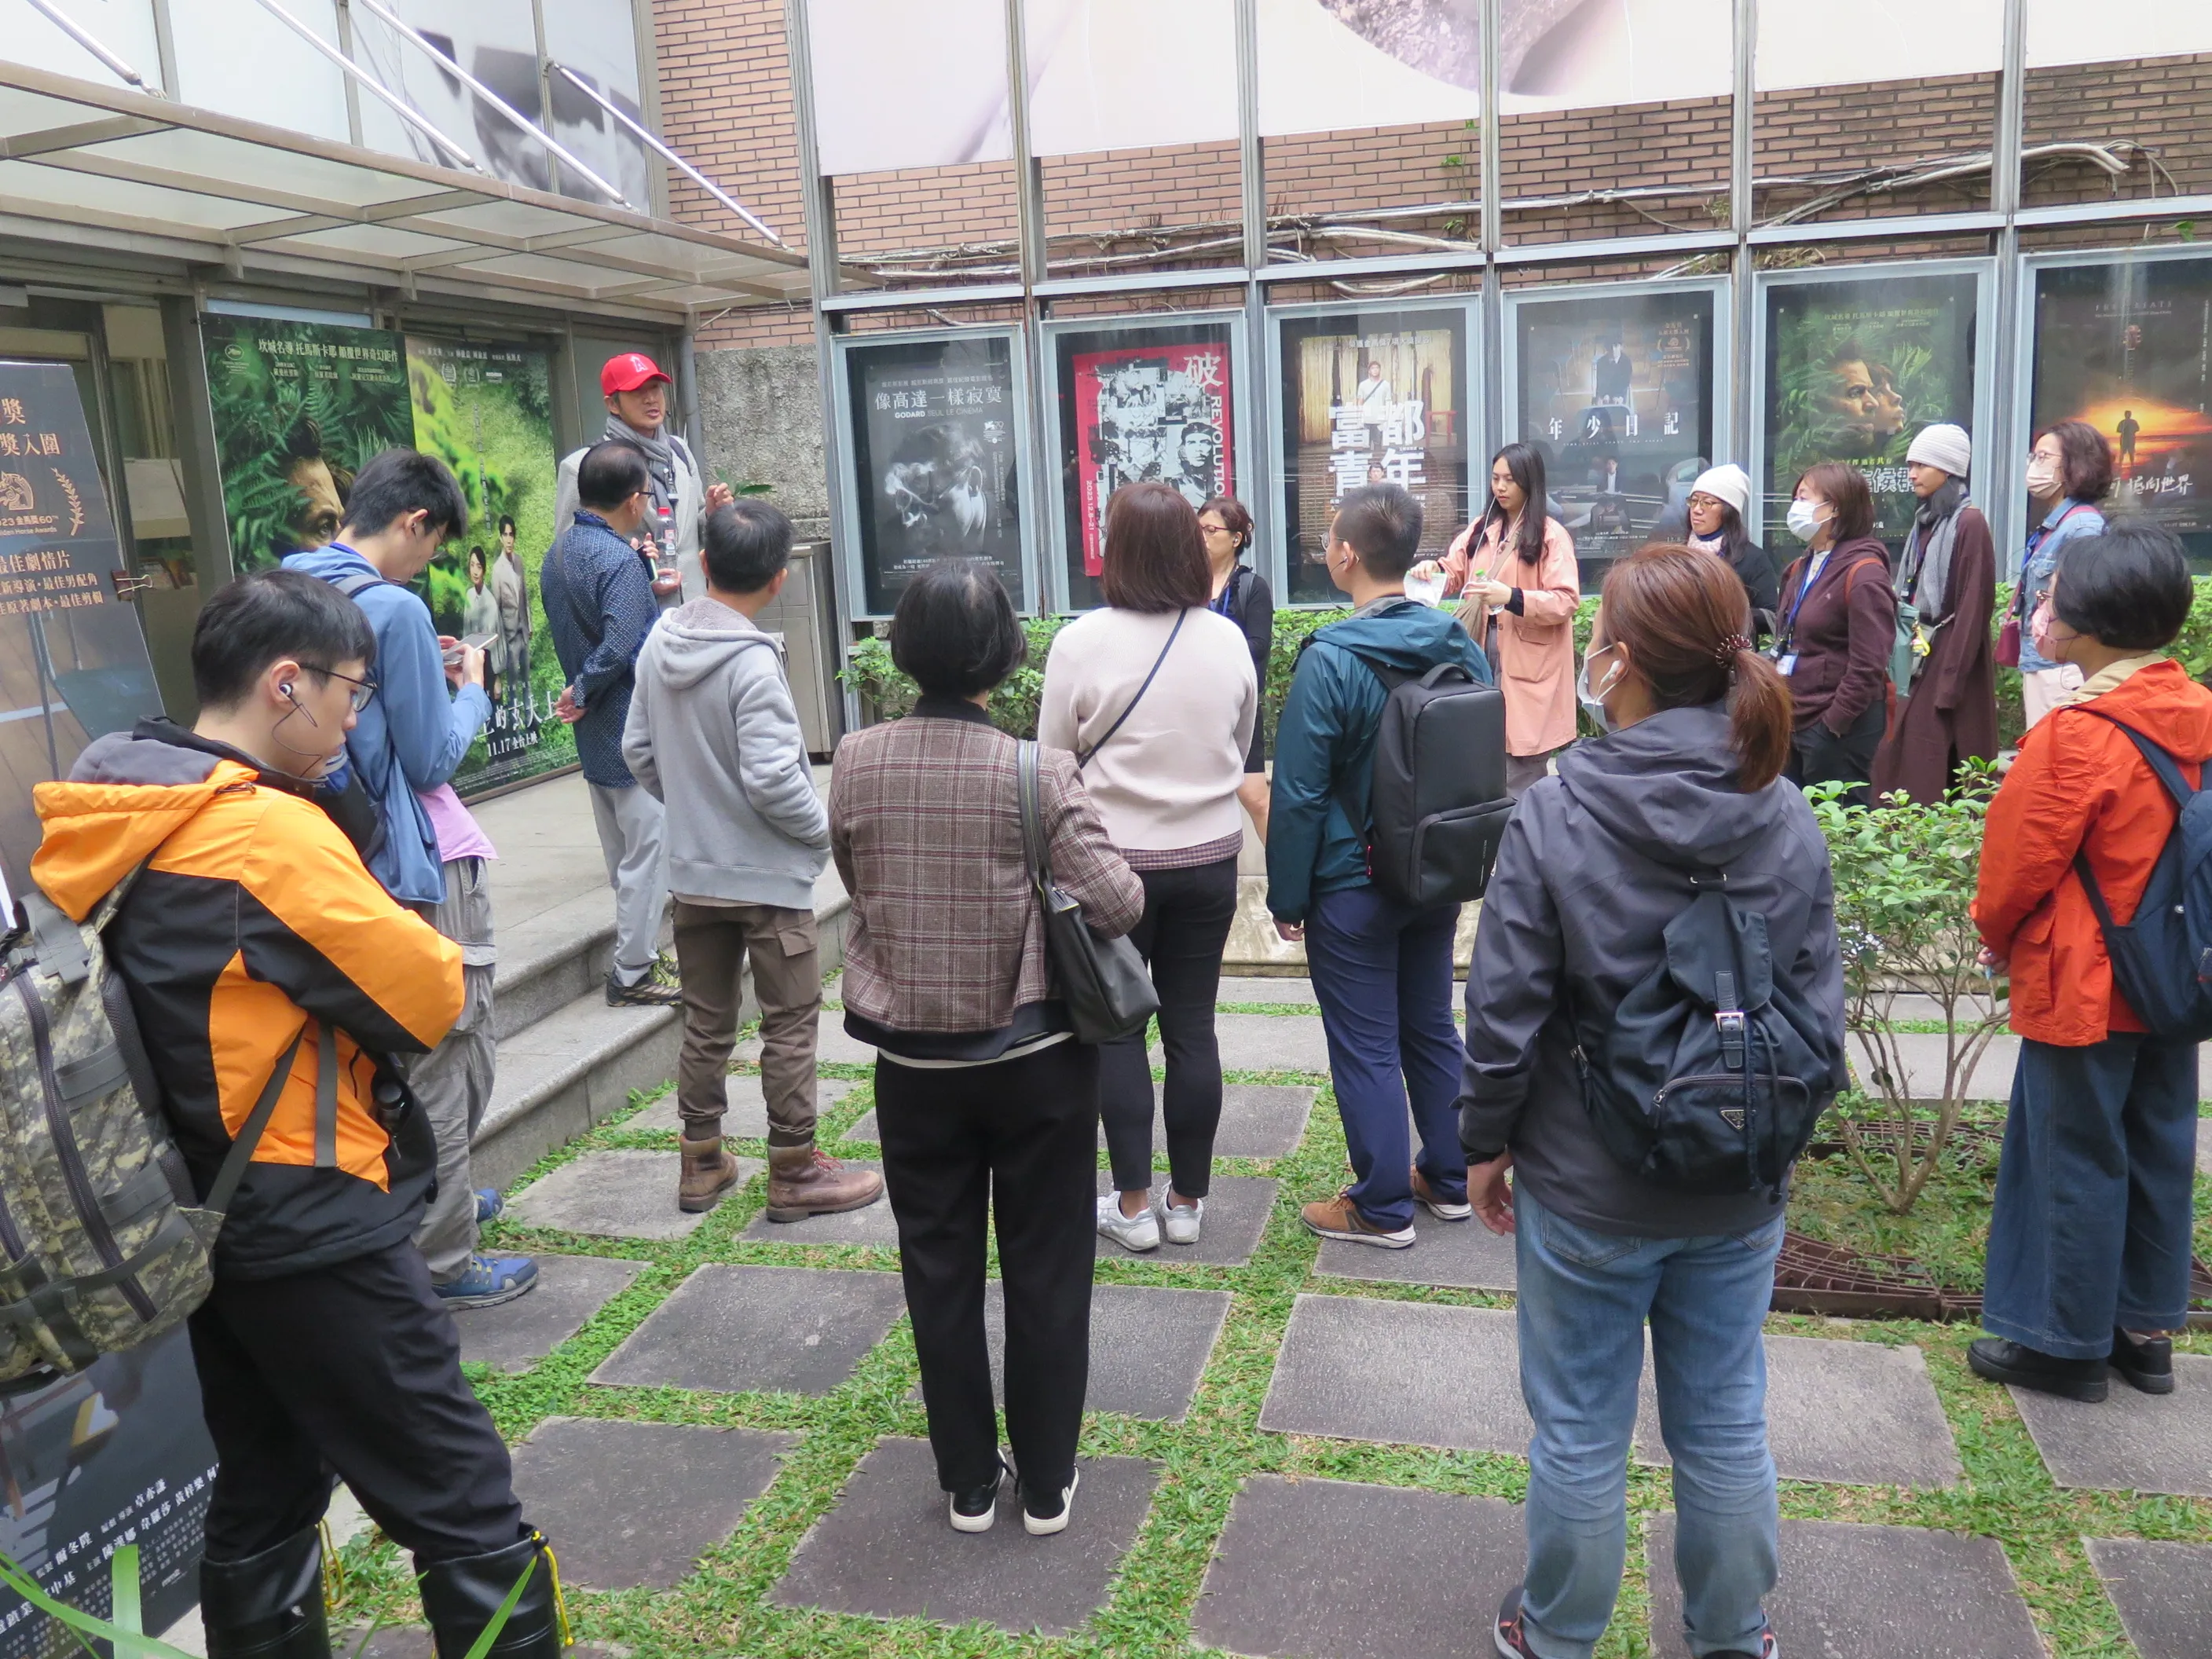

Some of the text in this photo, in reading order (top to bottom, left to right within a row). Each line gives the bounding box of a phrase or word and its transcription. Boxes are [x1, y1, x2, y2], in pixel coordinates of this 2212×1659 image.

[630, 356, 649, 372] A
[1184, 352, 1224, 390] 破
[875, 385, 1002, 410] 像高達一樣寂寞
[895, 410, 926, 419] GODARD
[1547, 412, 1679, 441] 年少日記
[1210, 395, 1225, 498] REVOLUTIO
